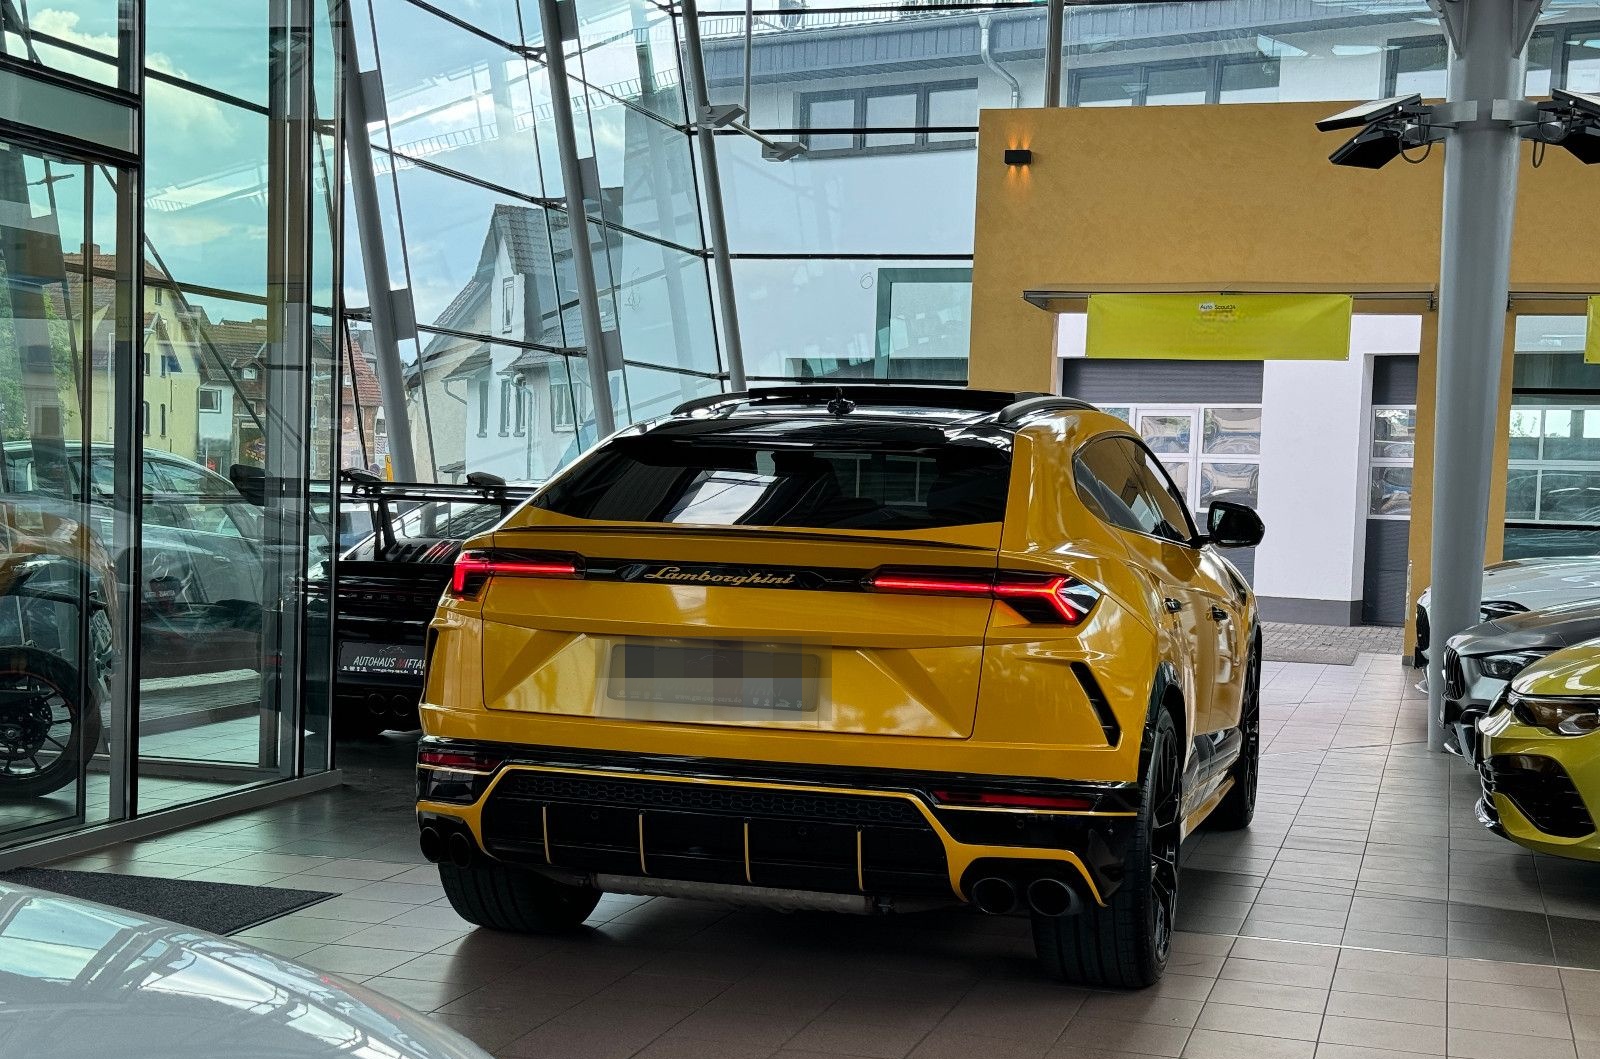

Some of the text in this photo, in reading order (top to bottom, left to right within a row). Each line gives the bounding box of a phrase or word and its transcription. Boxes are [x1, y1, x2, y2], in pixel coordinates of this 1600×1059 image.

[644, 566, 795, 585] Lamborghini
[353, 656, 426, 669] AUTOHAUS MIFTAR
